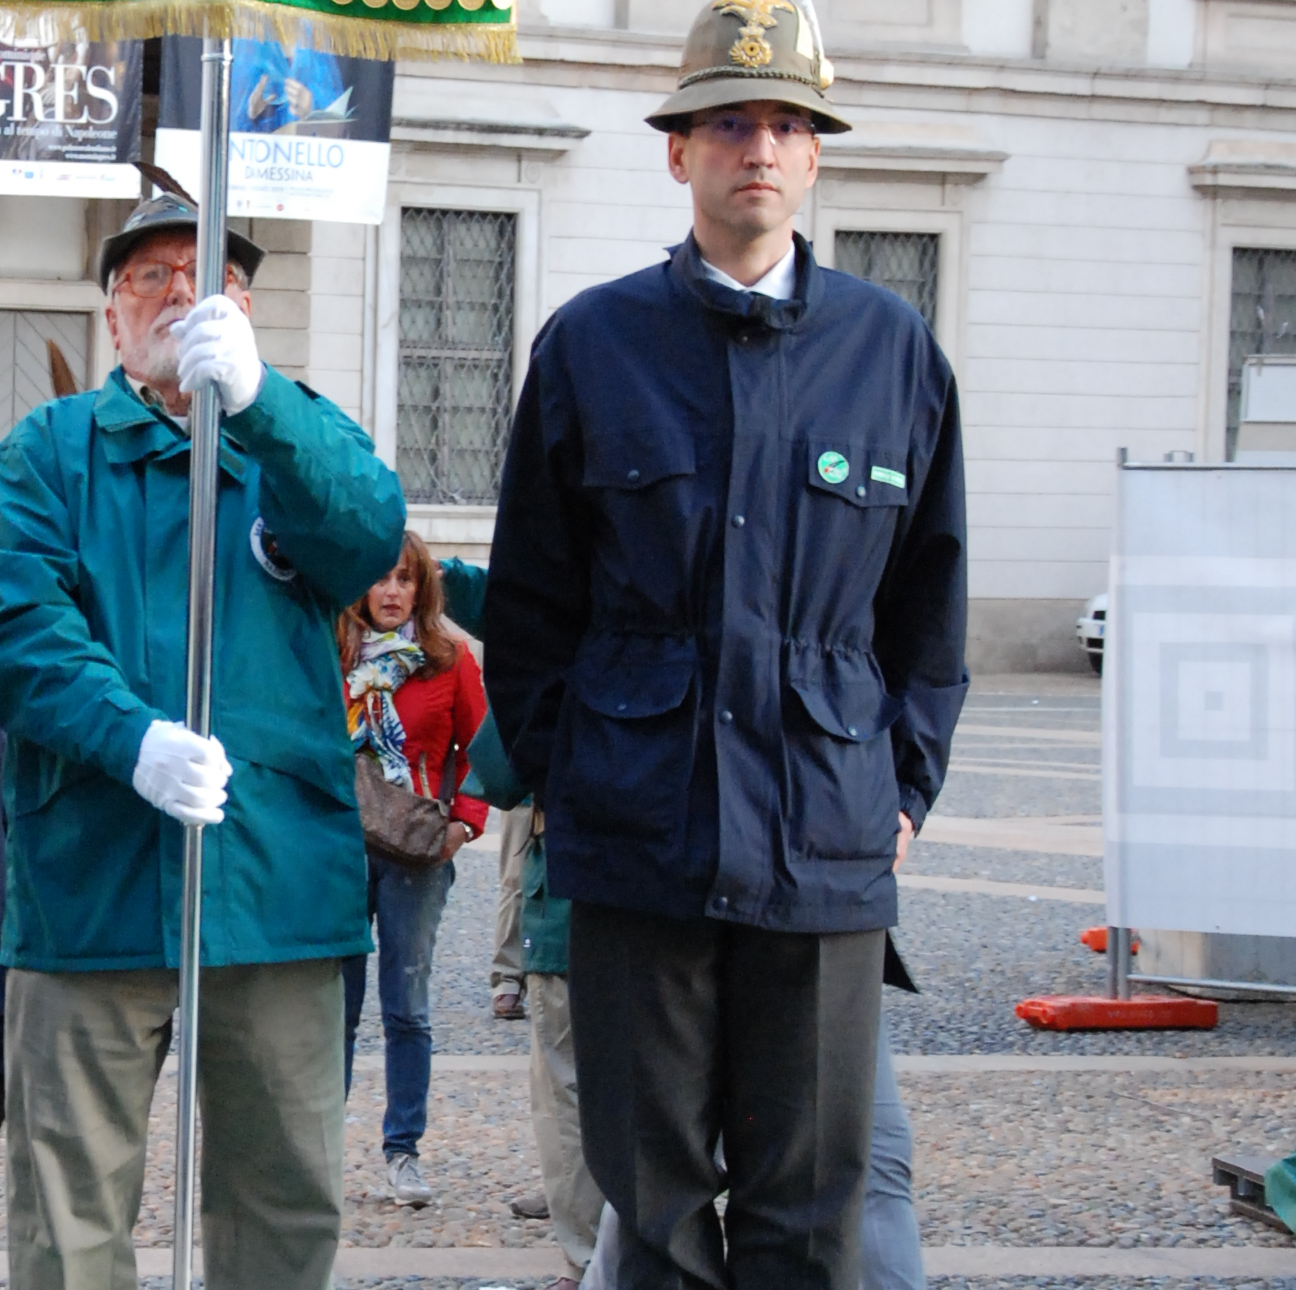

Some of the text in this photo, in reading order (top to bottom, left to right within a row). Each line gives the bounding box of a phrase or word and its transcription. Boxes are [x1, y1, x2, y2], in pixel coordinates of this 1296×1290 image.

[3, 123, 15, 136] al
[65, 127, 119, 143] Napoleone
[229, 139, 345, 168] NTONELLO
[255, 167, 314, 182] MESSINA
